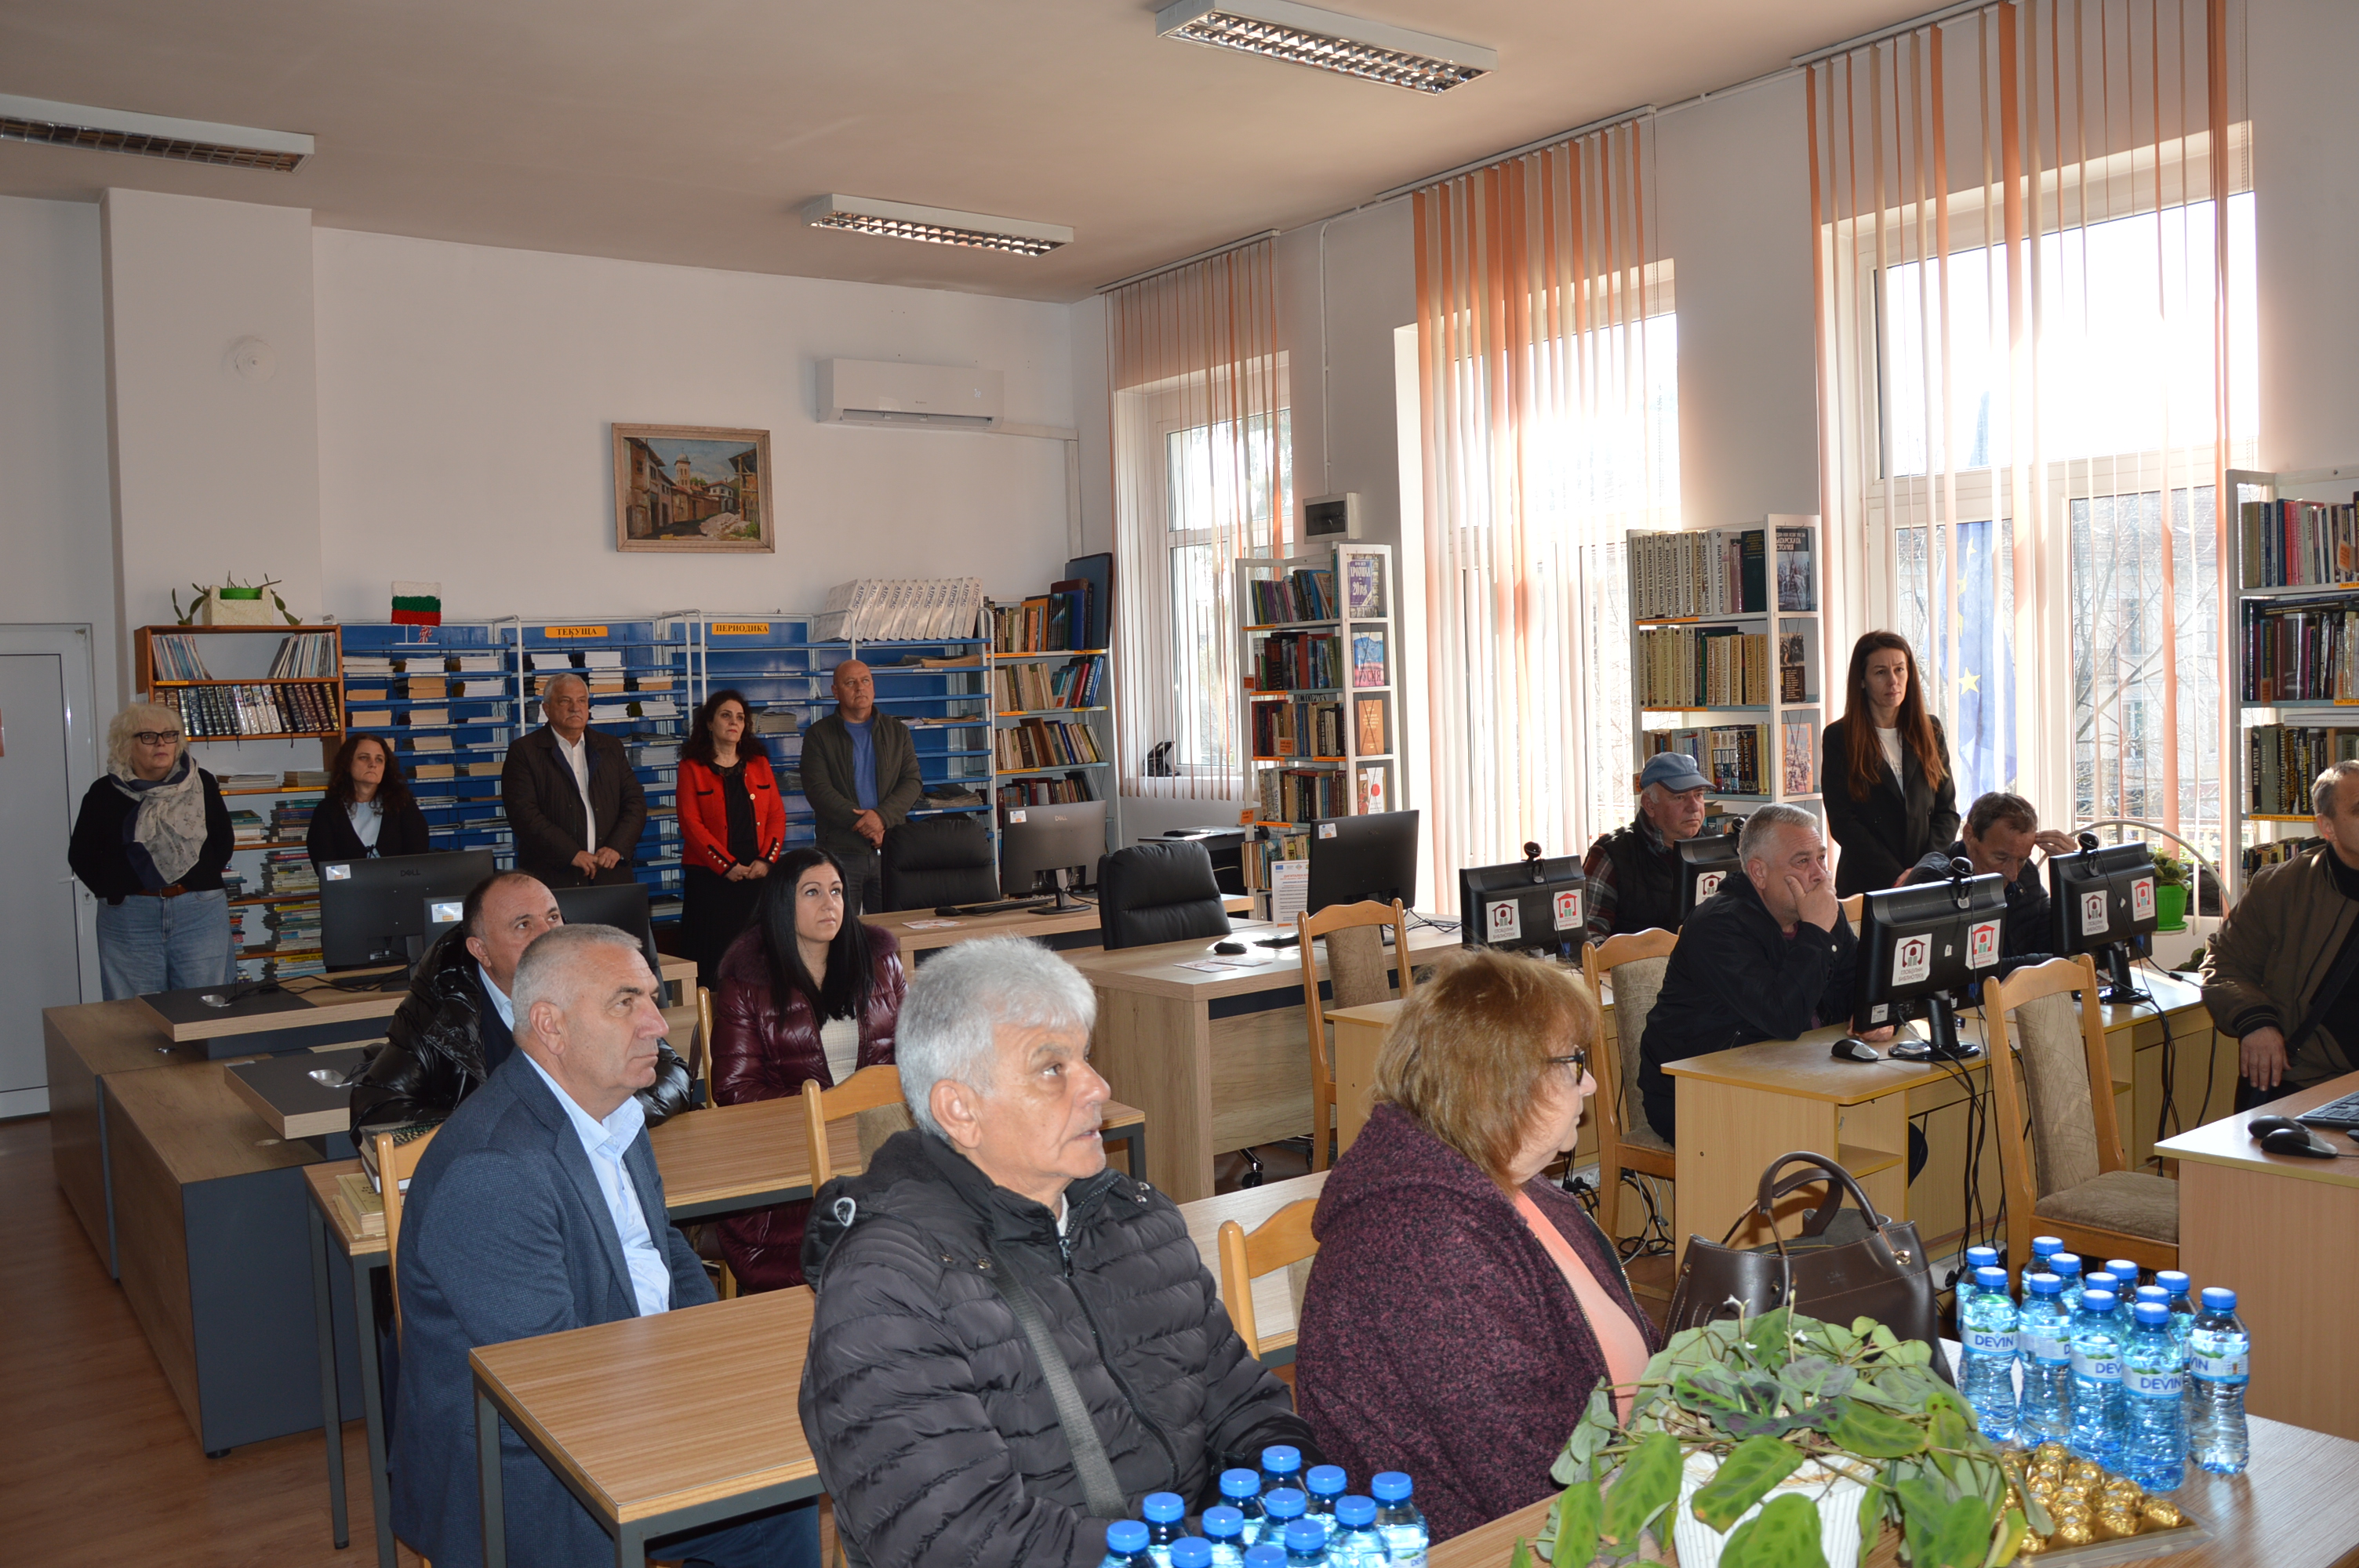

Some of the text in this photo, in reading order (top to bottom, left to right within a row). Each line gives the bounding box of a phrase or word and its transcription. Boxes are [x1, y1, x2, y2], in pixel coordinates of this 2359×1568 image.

[716, 624, 769, 633] ПЕРИОДИКА
[1898, 974, 1924, 982] БИБЛИОТЕКИ
[1975, 1334, 2014, 1348] DEVIN
[2095, 1363, 2121, 1374] DEV
[2141, 1377, 2181, 1390] DEVIN
